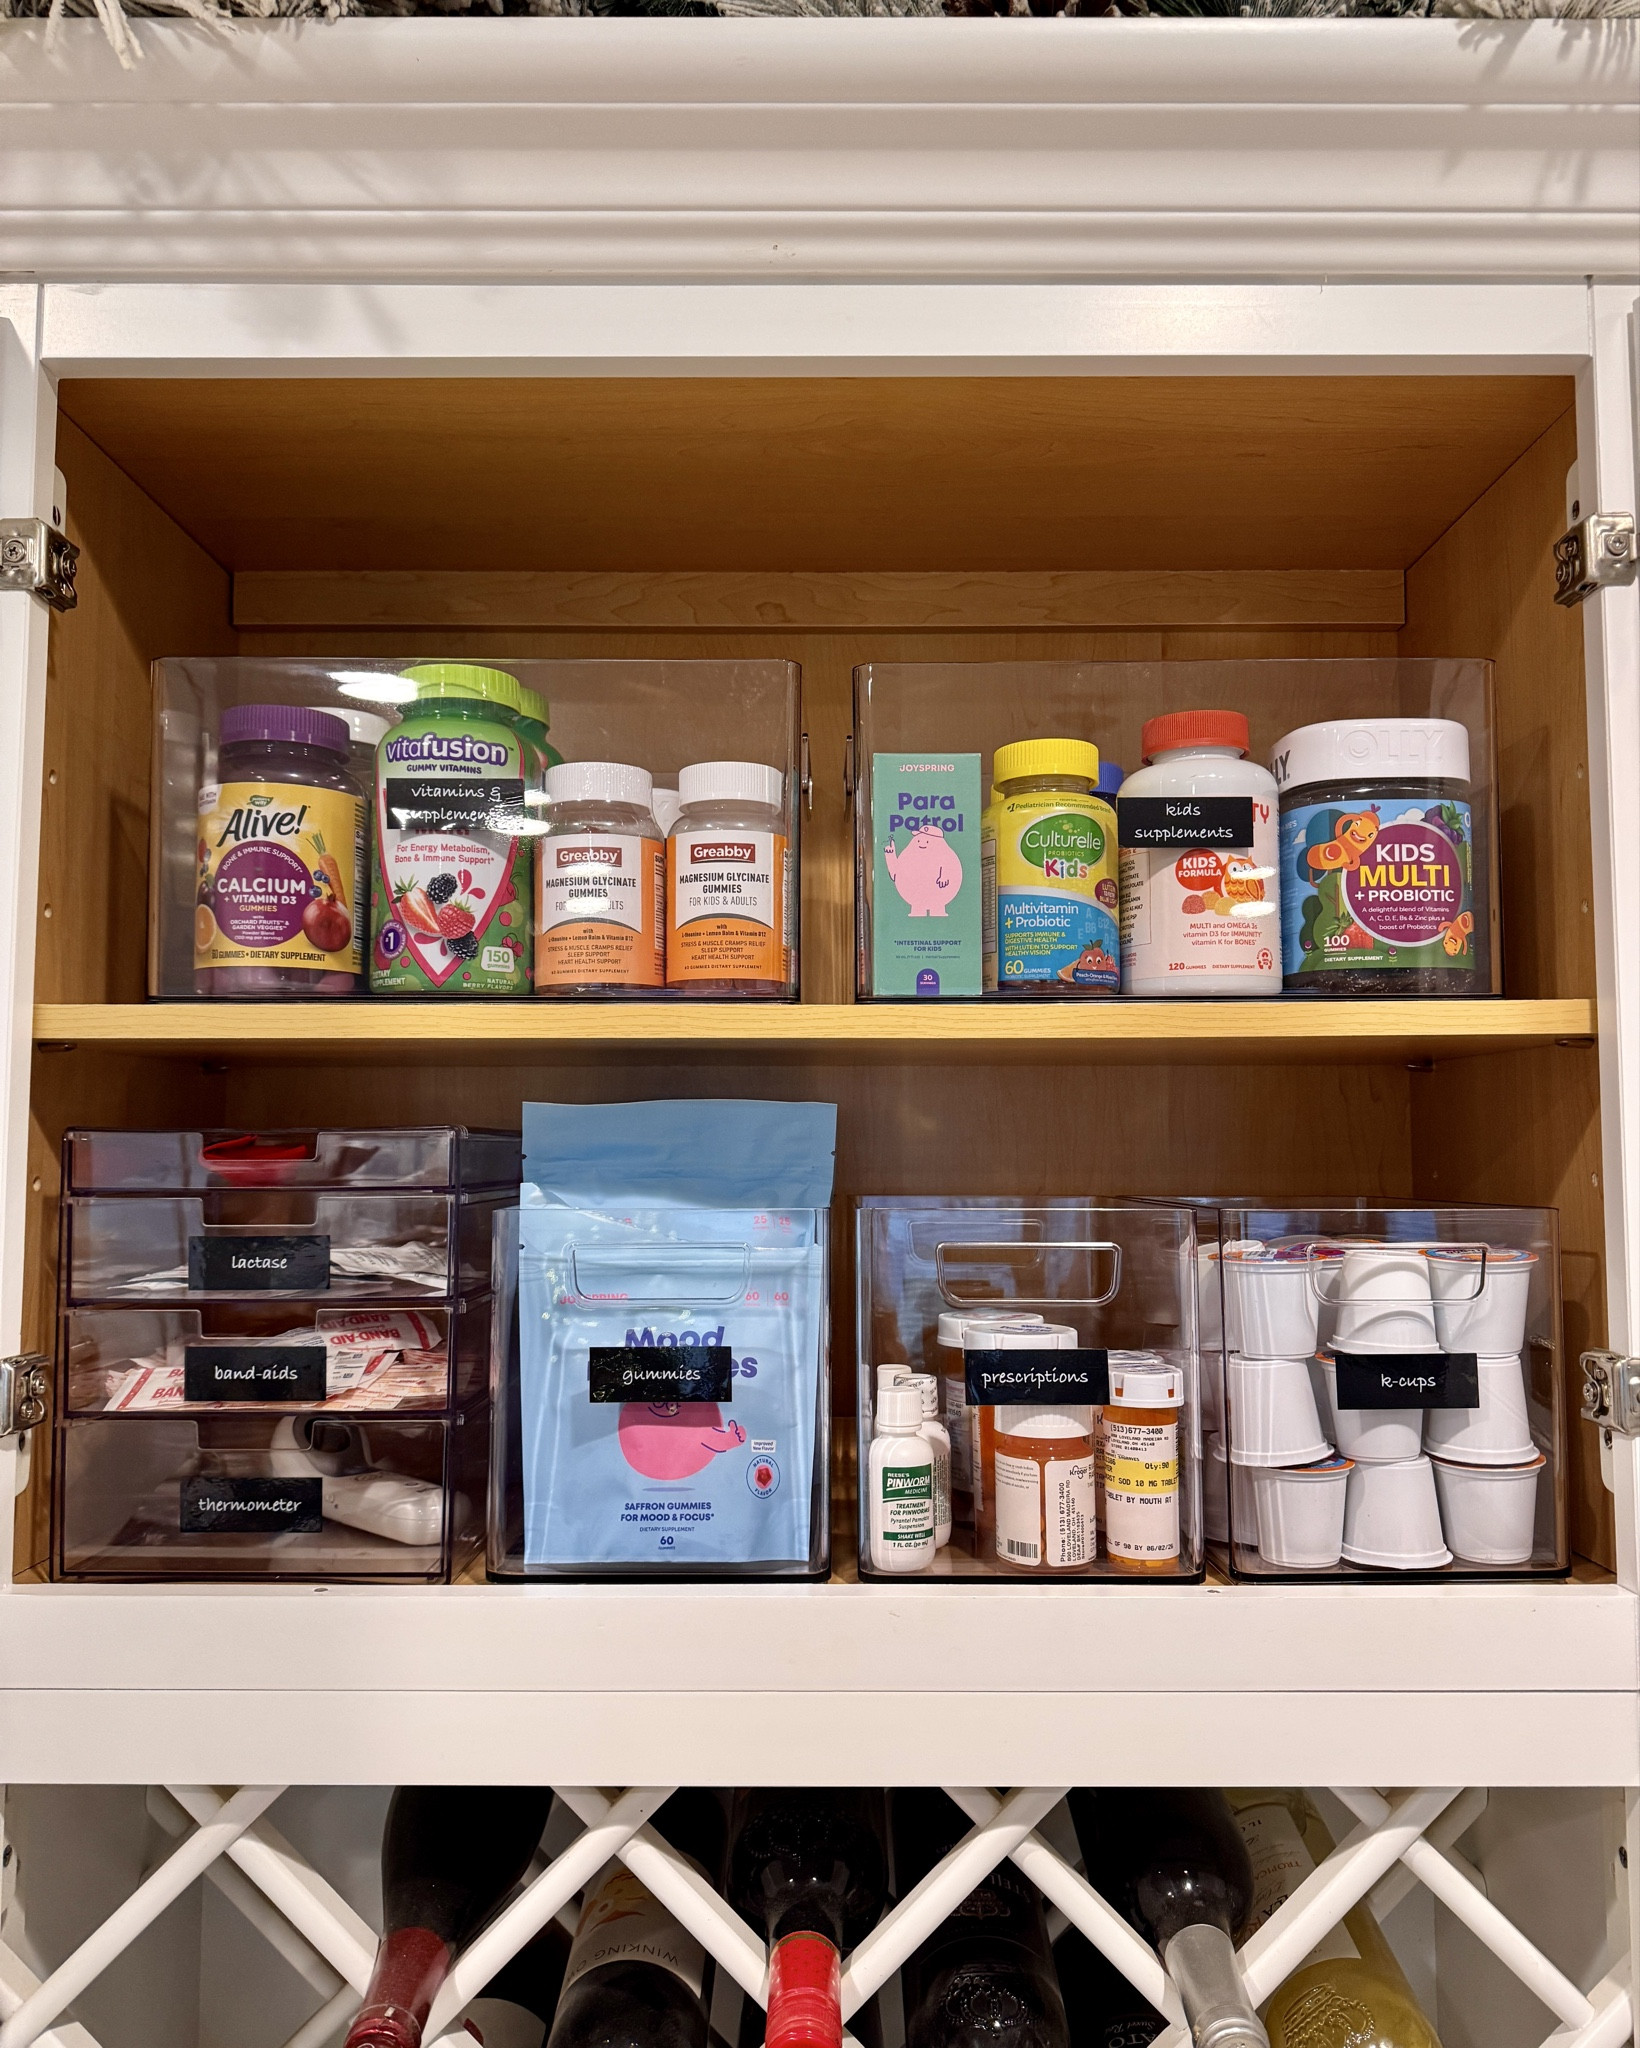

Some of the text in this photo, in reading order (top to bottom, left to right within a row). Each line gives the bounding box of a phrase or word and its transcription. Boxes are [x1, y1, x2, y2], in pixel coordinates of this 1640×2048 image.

[387, 734, 508, 763] vitafusion
[407, 764, 482, 774] GUMMY VITAMINS
[899, 764, 955, 772] JOYSPRING
[411, 784, 485, 798] vitamins
[898, 793, 955, 810] Para
[1055, 802, 1099, 811] Recommended
[1166, 802, 1201, 816] kids
[216, 804, 308, 847] Alive!
[890, 813, 963, 832] Patrol
[1134, 826, 1234, 841] supplements
[1025, 830, 1101, 850] Culturelle
[397, 844, 490, 855] For Energy Metabolism,
[694, 846, 751, 859] Greabby
[1376, 844, 1435, 862] KIDS
[222, 854, 237, 871] BONE
[243, 846, 271, 854] IMMUNE
[395, 855, 411, 863] Bone
[423, 855, 456, 863] Immune
[560, 850, 618, 863] Greabby
[1182, 857, 1217, 868] KIDS
[1045, 859, 1088, 878] Kids
[680, 873, 770, 884] MAGNESIUM GLYCINATE
[1360, 865, 1449, 887] MULTI
[217, 878, 306, 895] CALCIUM
[546, 877, 637, 888] MAGNESIUM GLYCINATE
[569, 889, 608, 898] GUMMIES
[703, 885, 742, 893] GUMMIES
[232, 894, 297, 905] VITAMIN D3
[689, 896, 757, 906] FOR KIDS & ADULTS
[1355, 890, 1454, 902] + PROBIOTIC
[1004, 902, 1079, 915] Multivitamin
[1005, 915, 1071, 928] + Probiotic
[1324, 935, 1350, 947] 100
[219, 950, 326, 962] GUMMIES DIETARY SUPPLEMENT
[487, 950, 510, 963] 150
[1005, 960, 1024, 974] 60
[1168, 963, 1185, 971] 120
[487, 978, 514, 986] NATURAL
[753, 1215, 791, 1226] 25 25
[745, 1291, 789, 1303] 60 60
[330, 1328, 401, 1345] BAND-AID
[624, 1325, 725, 1347] Mood
[214, 1364, 298, 1380] band-aids
[622, 1364, 701, 1385] gummies
[982, 1367, 1088, 1389] prescriptions
[1381, 1373, 1436, 1392] k-cups
[1110, 1424, 1164, 1435] (513)677-3400
[753, 1458, 774, 1468] NATURAL
[1145, 1462, 1169, 1470] Qty:90
[1070, 1465, 1087, 1479] Kroger
[887, 1475, 930, 1487] PINWORM
[754, 1488, 772, 1496] FLAVOR
[198, 1498, 302, 1512] thermometer
[625, 1502, 712, 1511] SAFFRON GUMMIES
[621, 1513, 638, 1522] FOR
[640, 1513, 670, 1522] MOOD
[672, 1513, 678, 1521] &
[902, 1507, 930, 1516] PINWORMS
[660, 1536, 674, 1545] 60
[594, 1943, 678, 1967] WINKING
